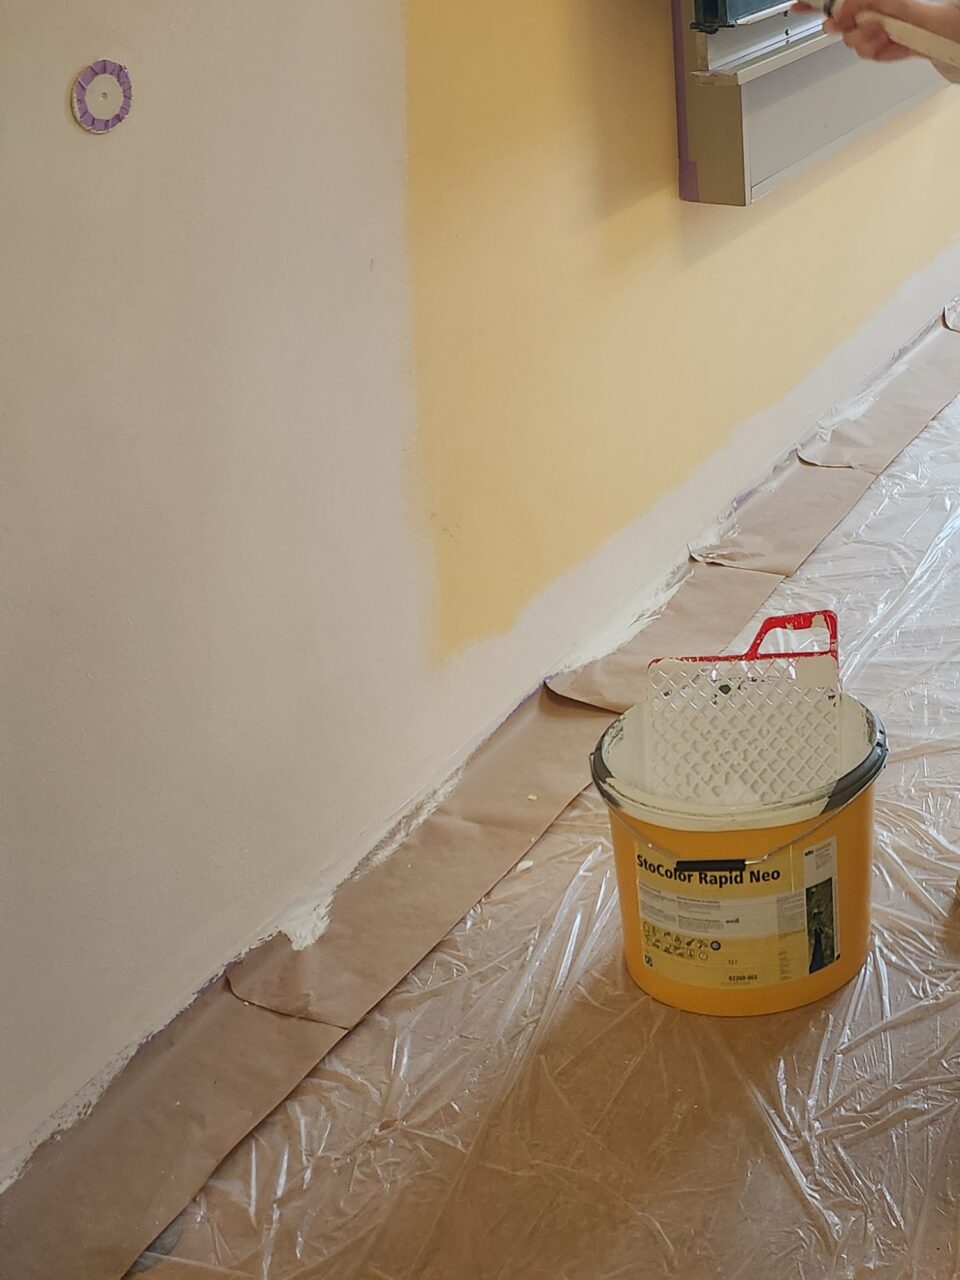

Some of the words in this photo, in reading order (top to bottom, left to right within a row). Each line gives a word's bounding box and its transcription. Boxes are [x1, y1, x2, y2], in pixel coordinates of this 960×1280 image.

[636, 854, 693, 883] StoColor
[699, 870, 744, 888] Rapid
[749, 870, 781, 883] Neo
